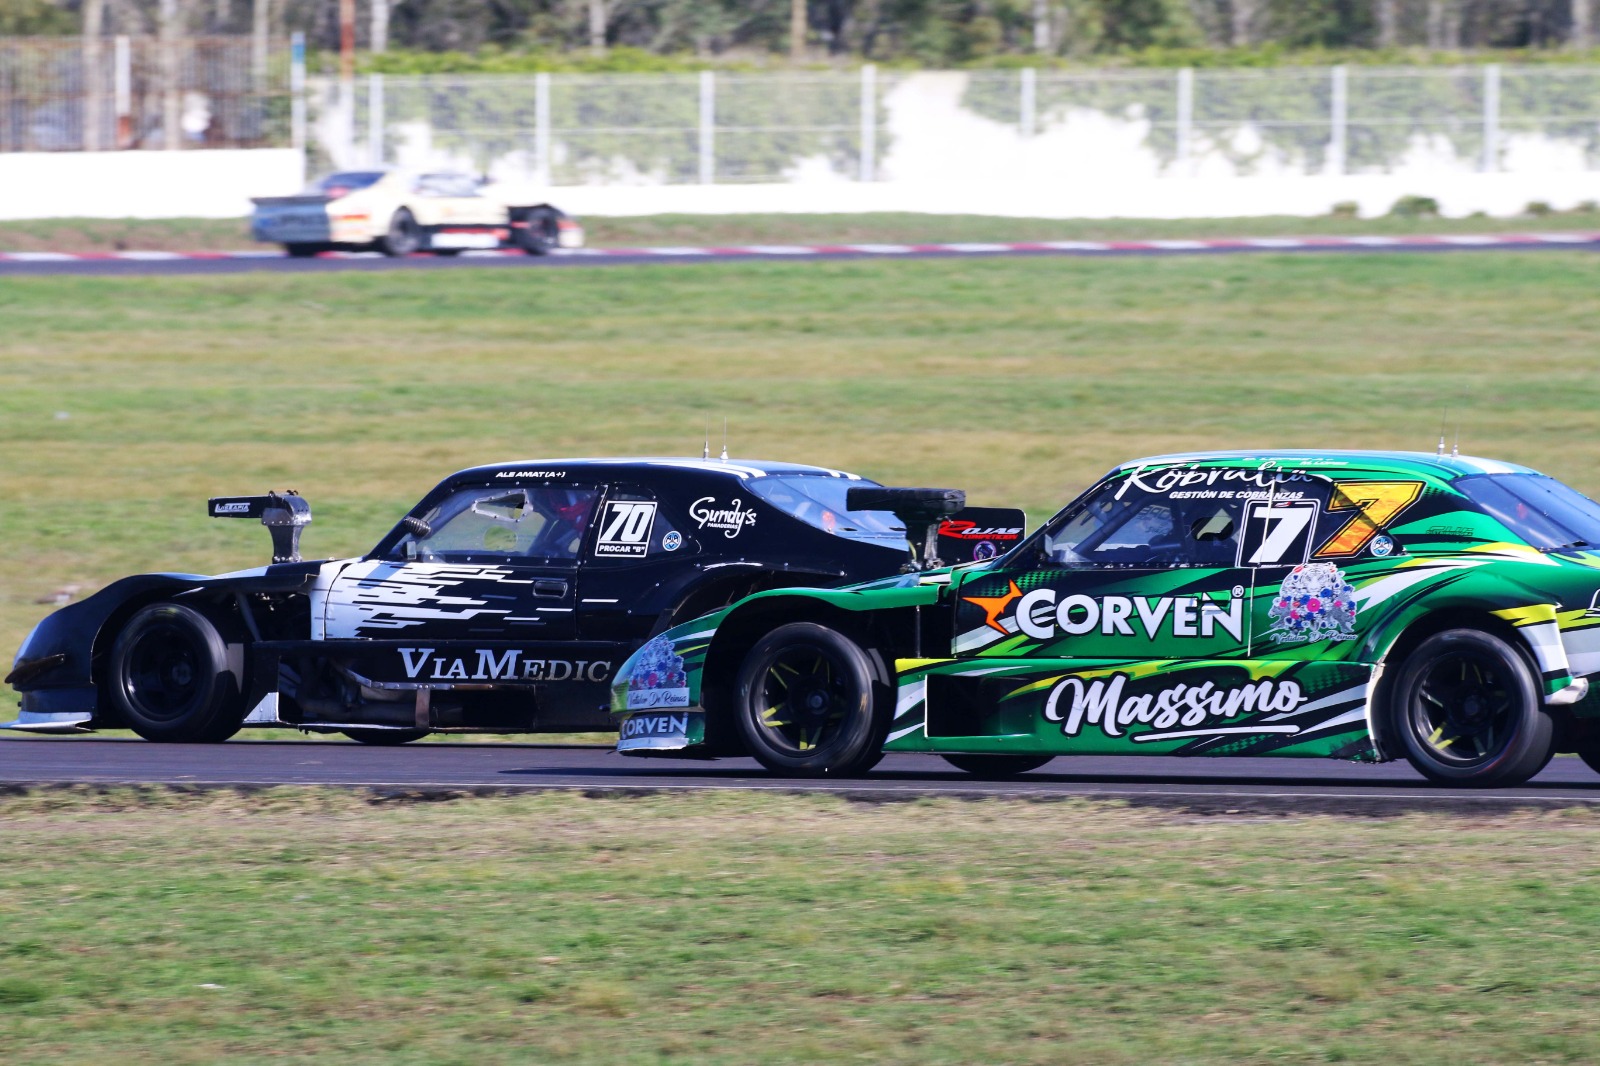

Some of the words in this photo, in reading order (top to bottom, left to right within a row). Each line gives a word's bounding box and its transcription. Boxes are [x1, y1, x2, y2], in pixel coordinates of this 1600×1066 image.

[1169, 489, 1210, 499] GESTIÓN
[1216, 491, 1234, 499] DE
[1235, 491, 1304, 500] COBRANZAS
[600, 503, 655, 542] 70
[689, 496, 757, 539] Gundy's
[938, 520, 1024, 539] ROJAS
[1248, 506, 1314, 563] 7
[1313, 480, 1426, 559] 7
[598, 544, 631, 553] PROCAR
[632, 545, 646, 553] "B"
[1015, 588, 1243, 643] CORVEN
[621, 714, 689, 740] CORVEN
